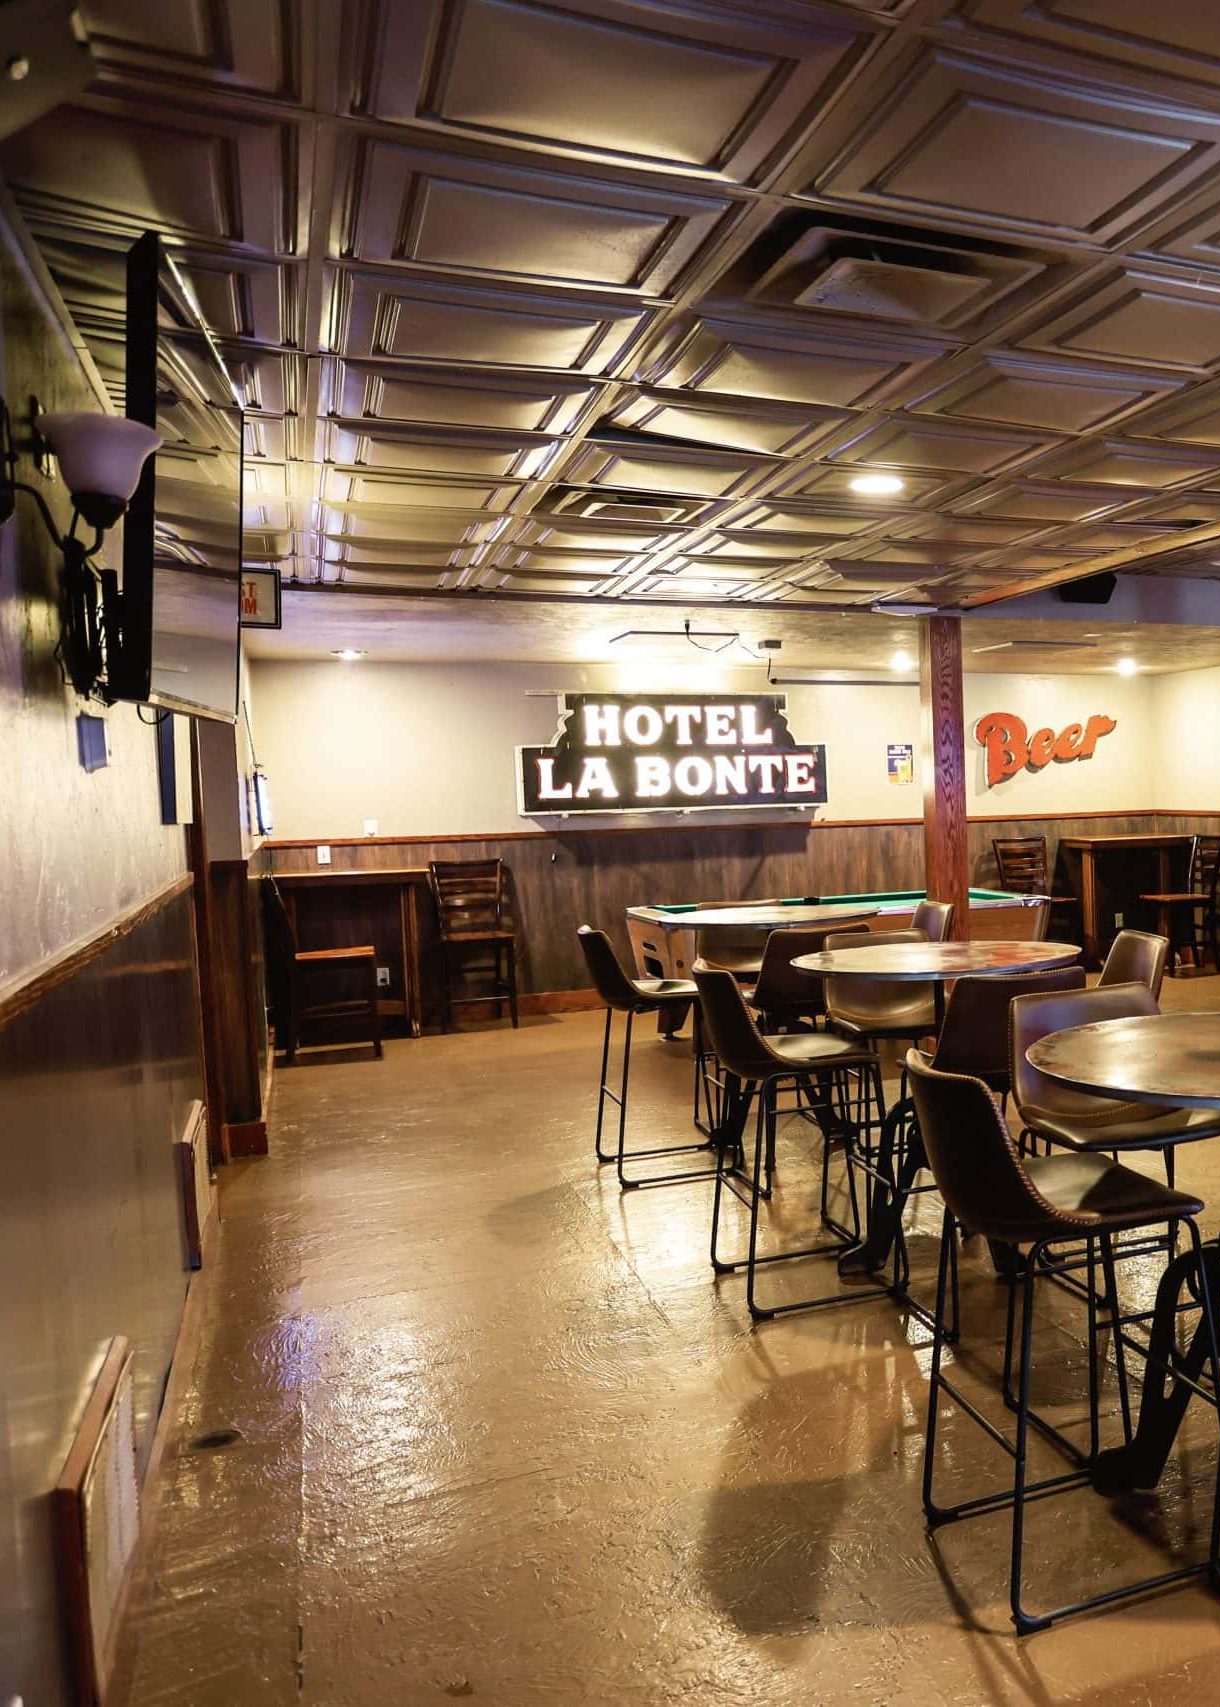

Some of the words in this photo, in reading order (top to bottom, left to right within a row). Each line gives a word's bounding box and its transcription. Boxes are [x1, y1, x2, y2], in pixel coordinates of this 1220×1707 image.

[583, 705, 773, 746] HOTEL
[974, 712, 1117, 788] Beer
[536, 758, 619, 799] LA
[634, 753, 816, 797] BONTE
